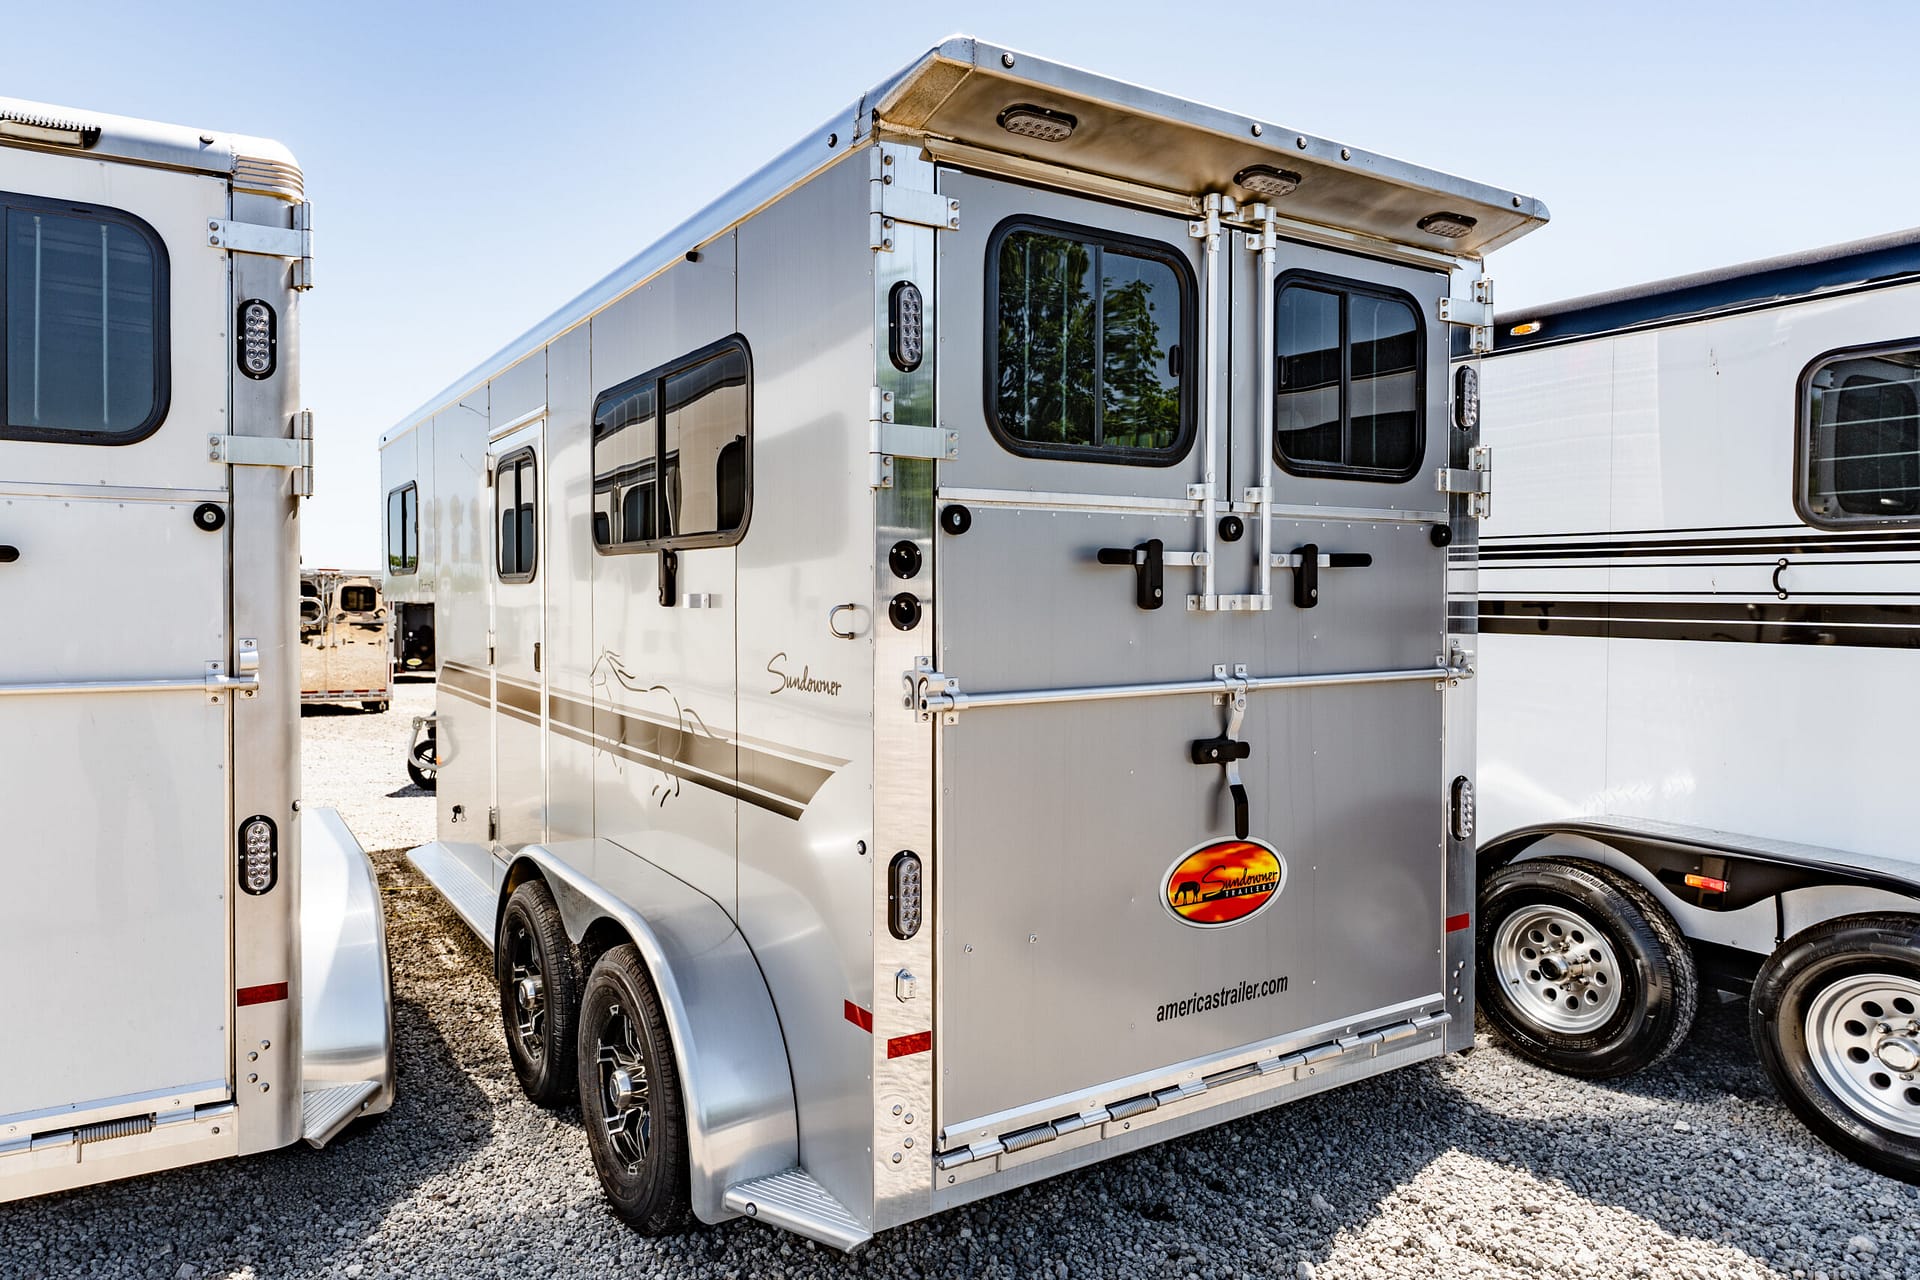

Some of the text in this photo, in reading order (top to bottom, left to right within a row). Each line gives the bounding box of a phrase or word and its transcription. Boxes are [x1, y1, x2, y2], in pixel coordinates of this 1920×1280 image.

[767, 652, 842, 696] Sundowner
[1201, 865, 1278, 896] Sundowner
[1225, 883, 1273, 898] TRAILERS
[1156, 975, 1288, 1022] americastrailer.com
